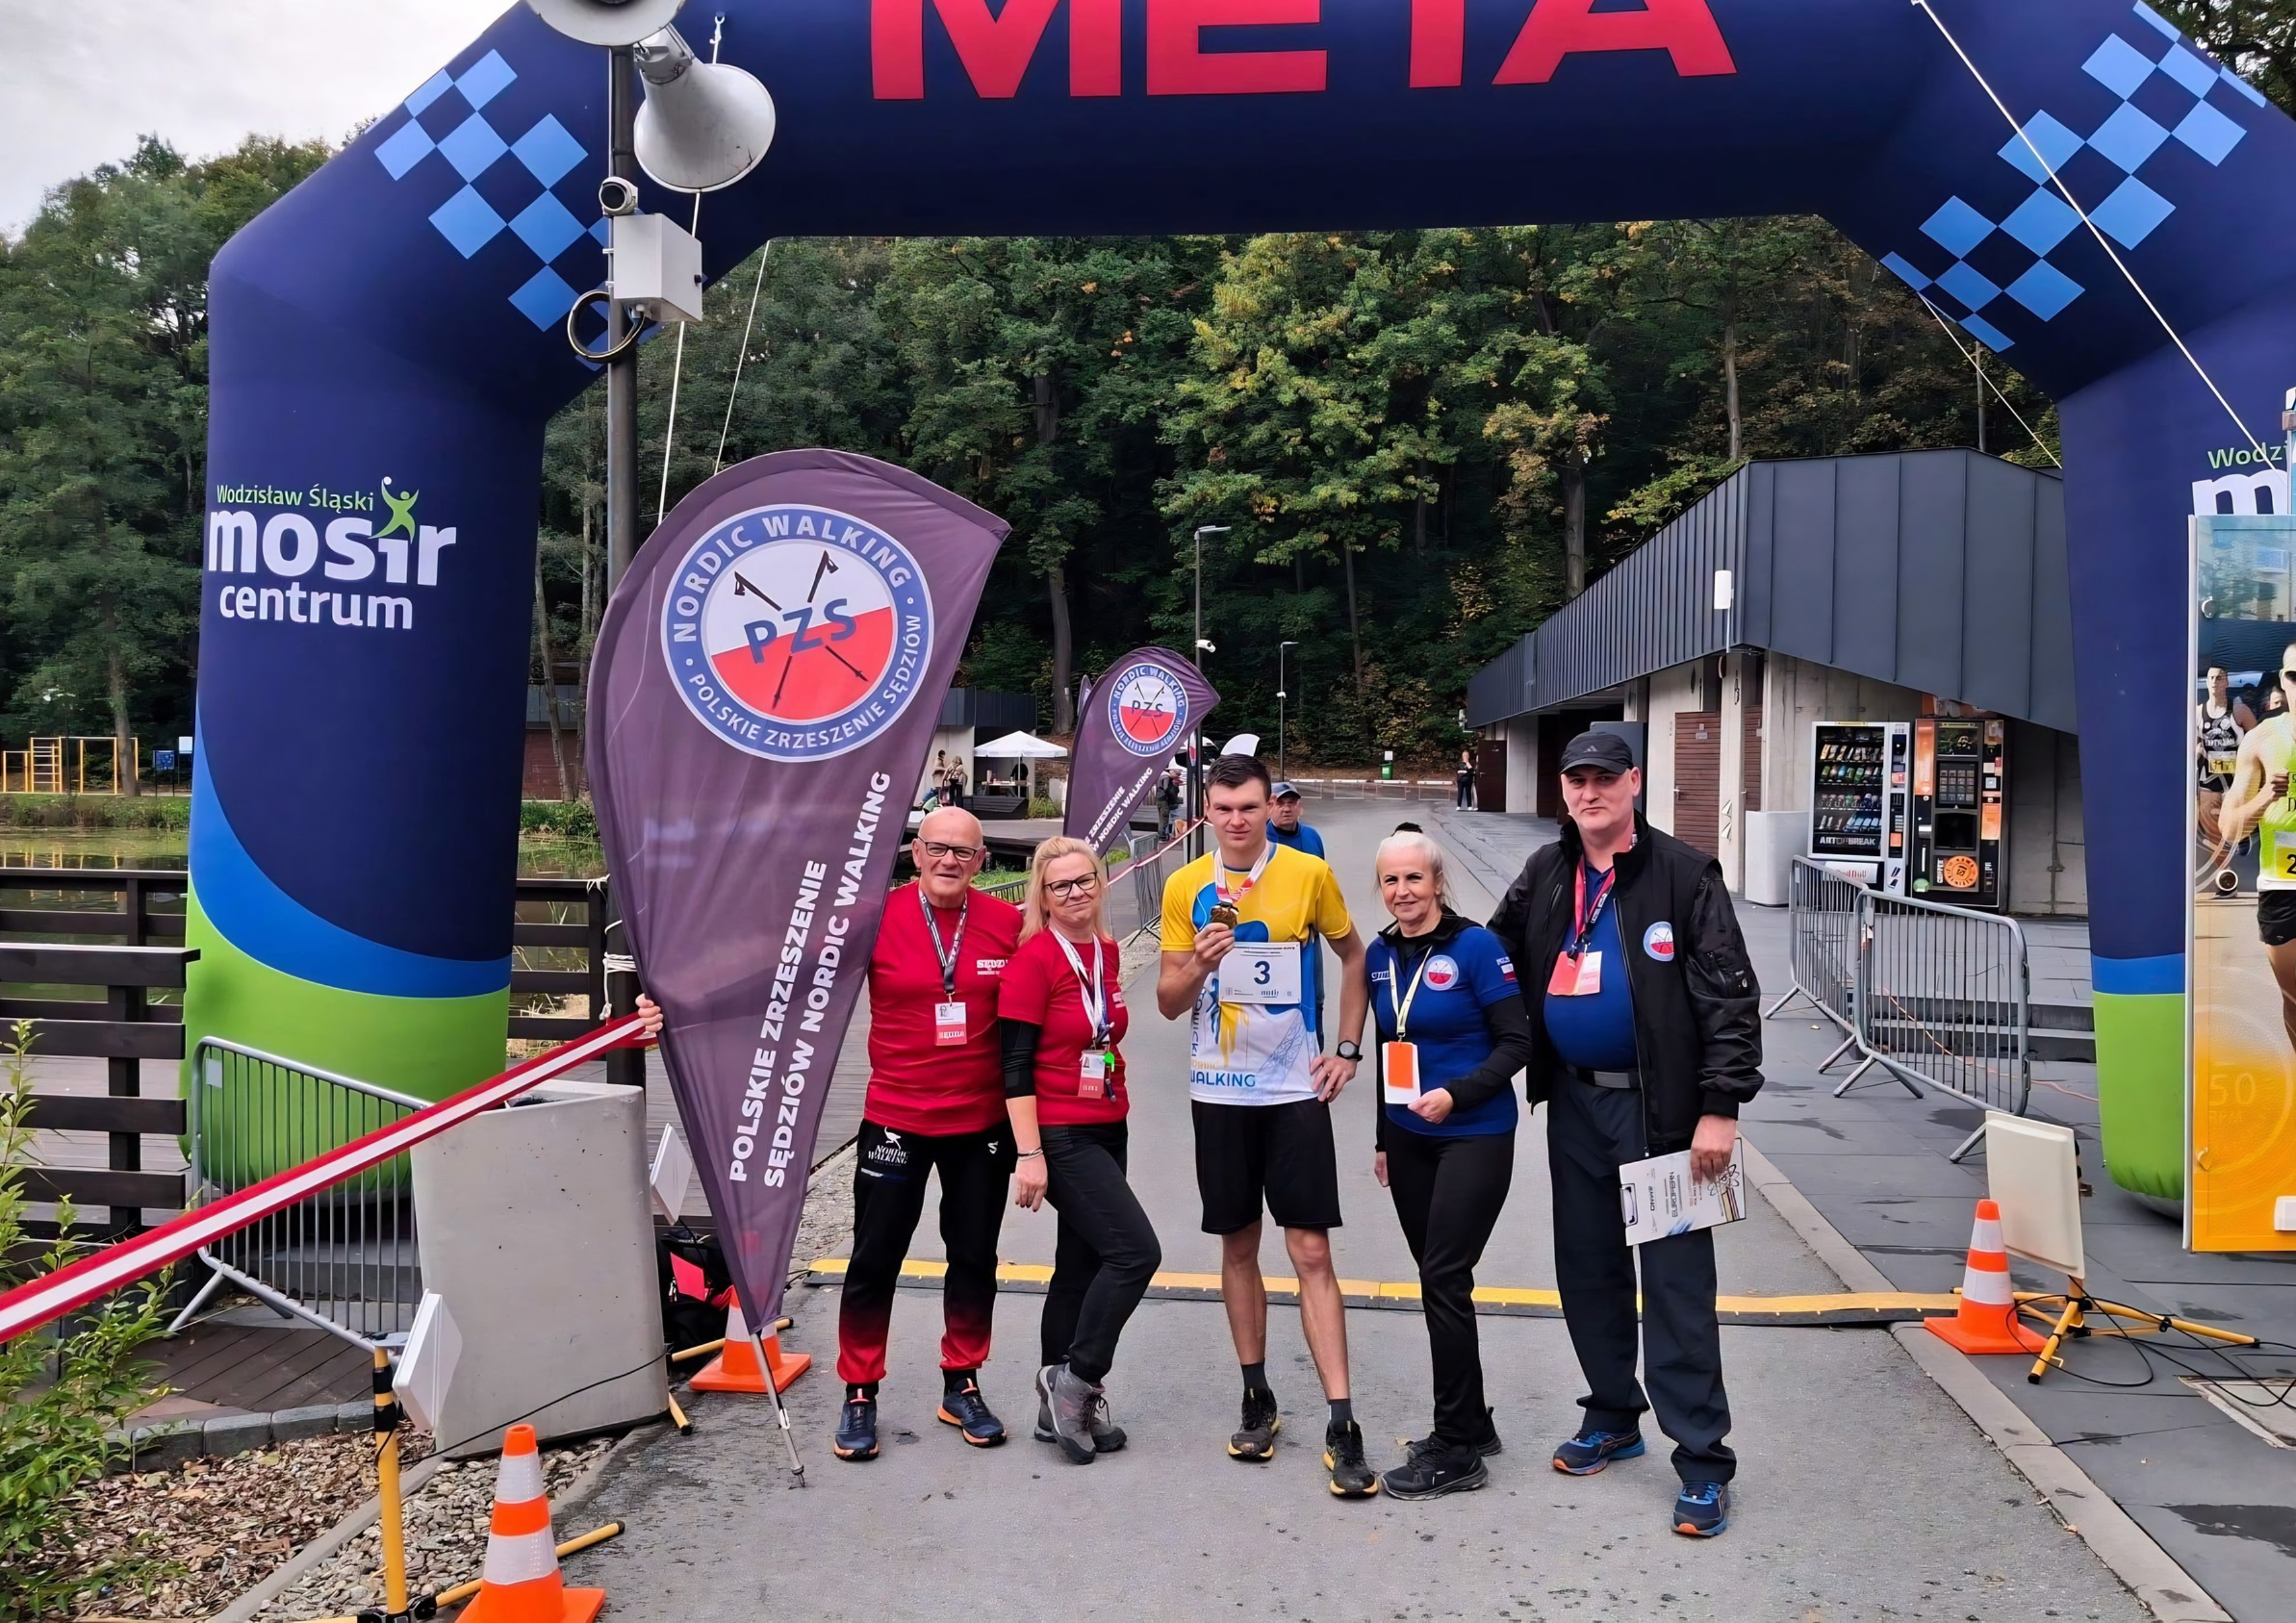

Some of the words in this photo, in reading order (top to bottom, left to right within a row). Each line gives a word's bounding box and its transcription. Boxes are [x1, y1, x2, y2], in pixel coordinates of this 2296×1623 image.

[217, 484, 302, 506] Wodzisław
[309, 484, 374, 513] Śląski
[208, 510, 457, 586] mosir
[673, 526, 753, 642] NORDIC
[762, 514, 912, 588] WALKING
[219, 582, 412, 629] centrum
[744, 598, 856, 664] PZS
[689, 673, 761, 741] POLSKIE
[764, 702, 886, 750] ZRZESZENIE
[883, 615, 921, 705] SĘDZIÓW
[1121, 767, 1153, 808] WALKING
[763, 1038, 815, 1188] SĘDZIÓW
[800, 915, 850, 1033] NORDIC
[834, 770, 891, 906] WALKING
[1253, 960, 1271, 985] 3
[729, 1048, 776, 1181] POLSKIE
[761, 860, 827, 1042] ZRZESZENIE
